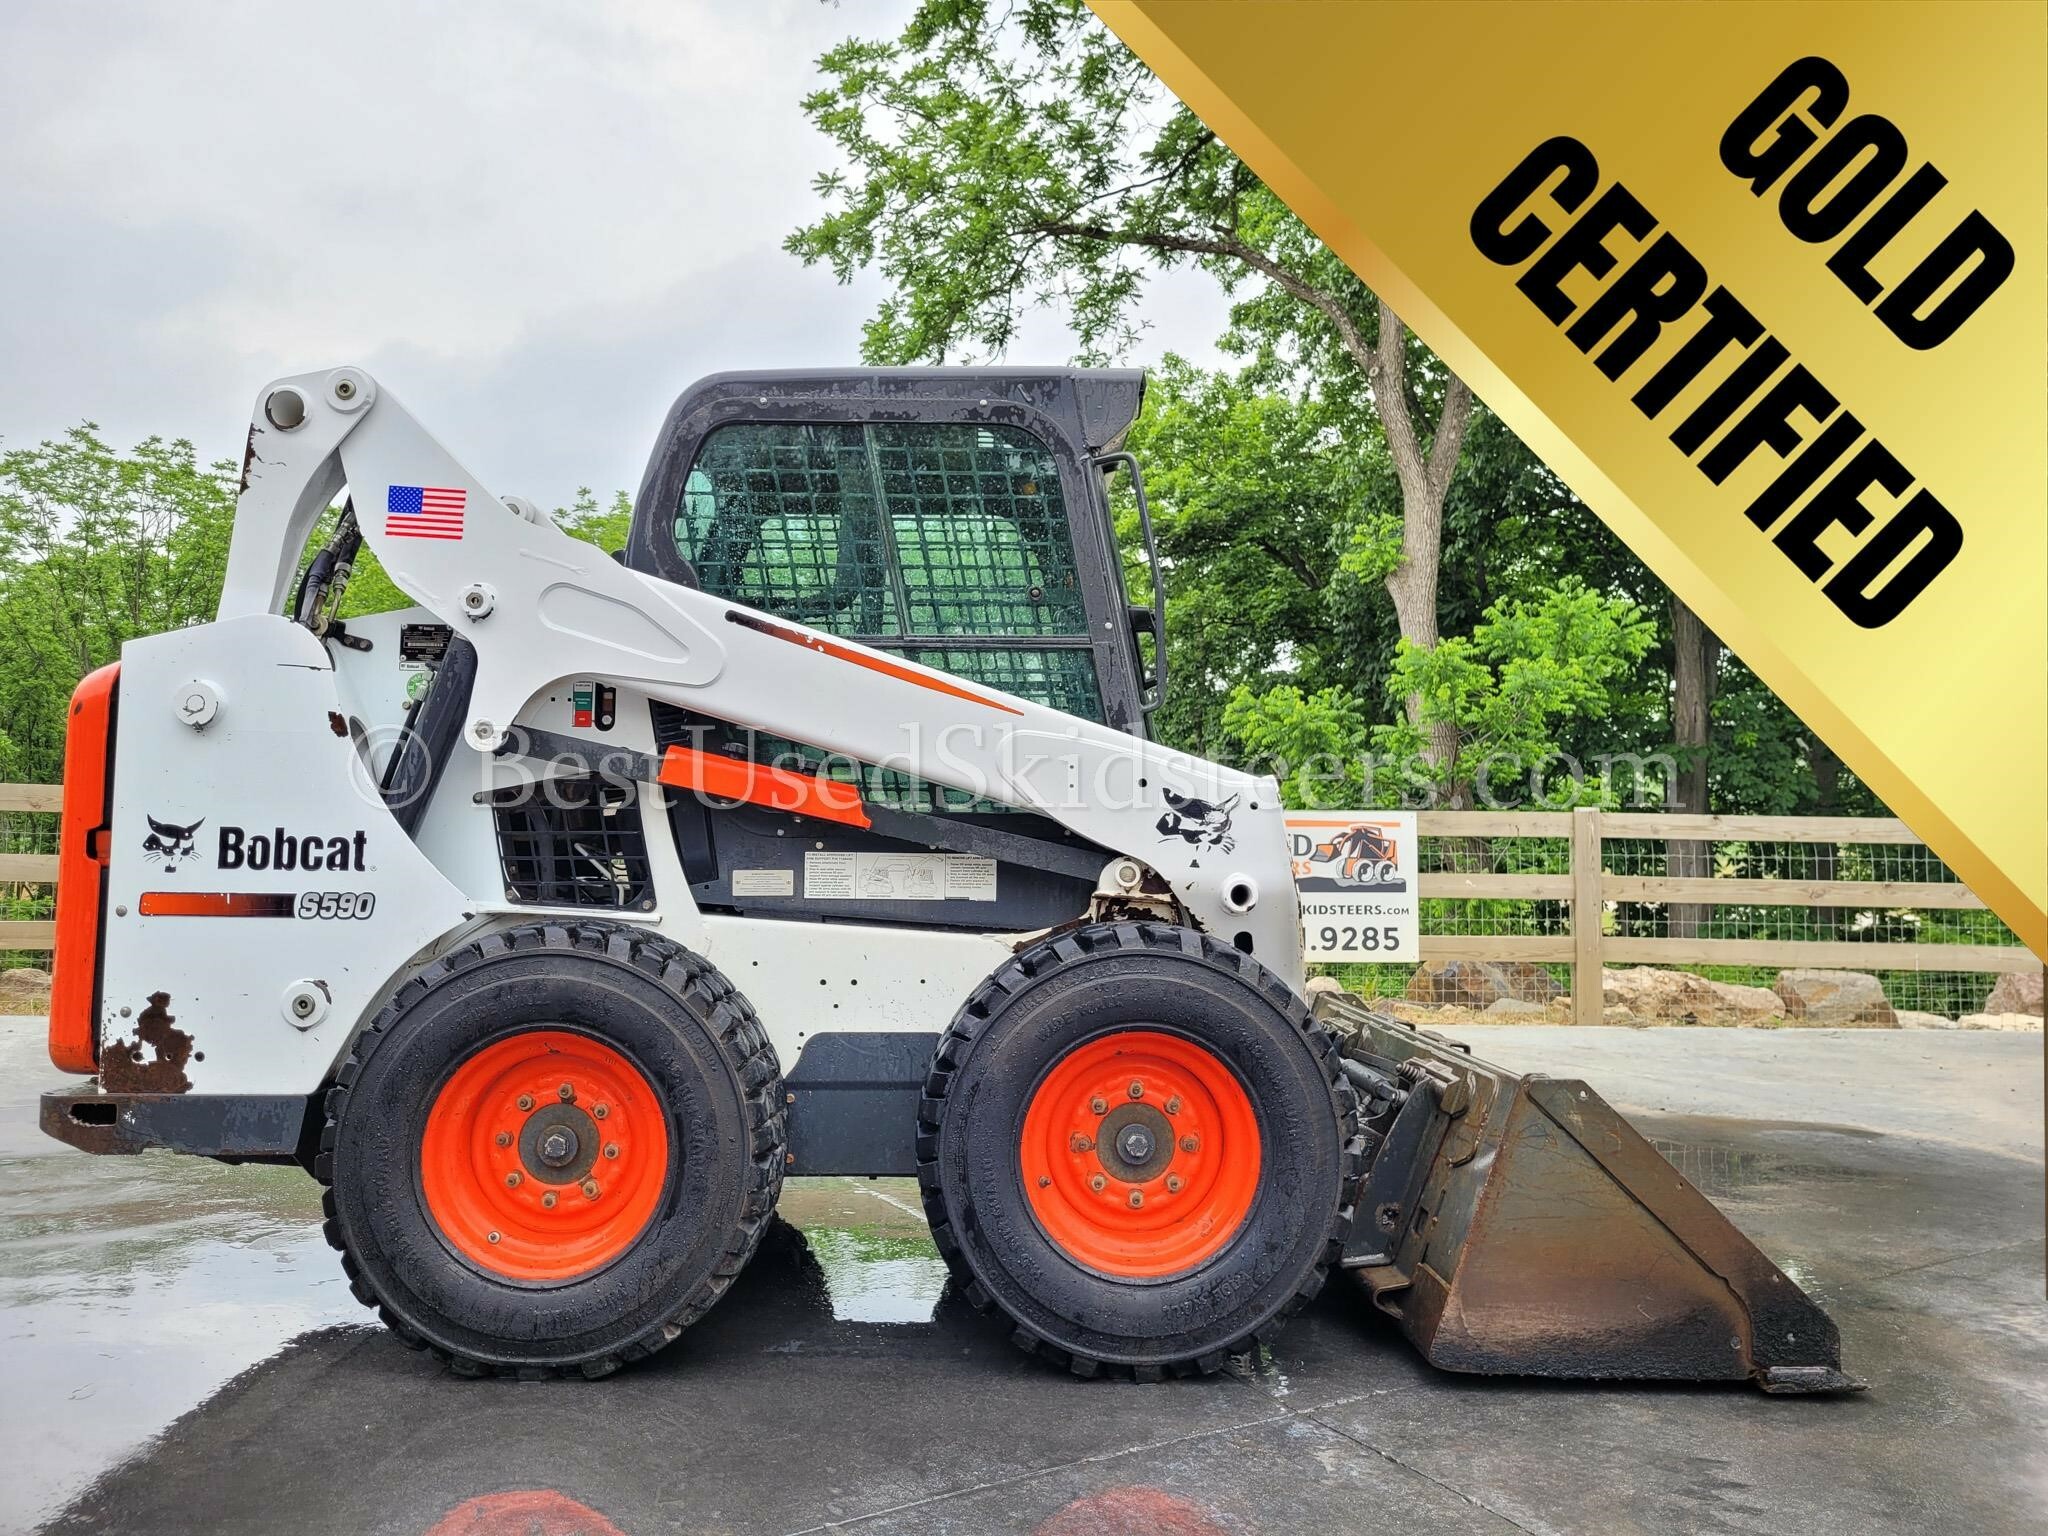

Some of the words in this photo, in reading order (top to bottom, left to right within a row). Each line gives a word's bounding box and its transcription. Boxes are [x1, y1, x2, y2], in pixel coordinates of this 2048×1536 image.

[218, 827, 368, 872] Bobcat
[298, 892, 376, 921] S590
[1302, 904, 1410, 915] KIDSTEERS.COM
